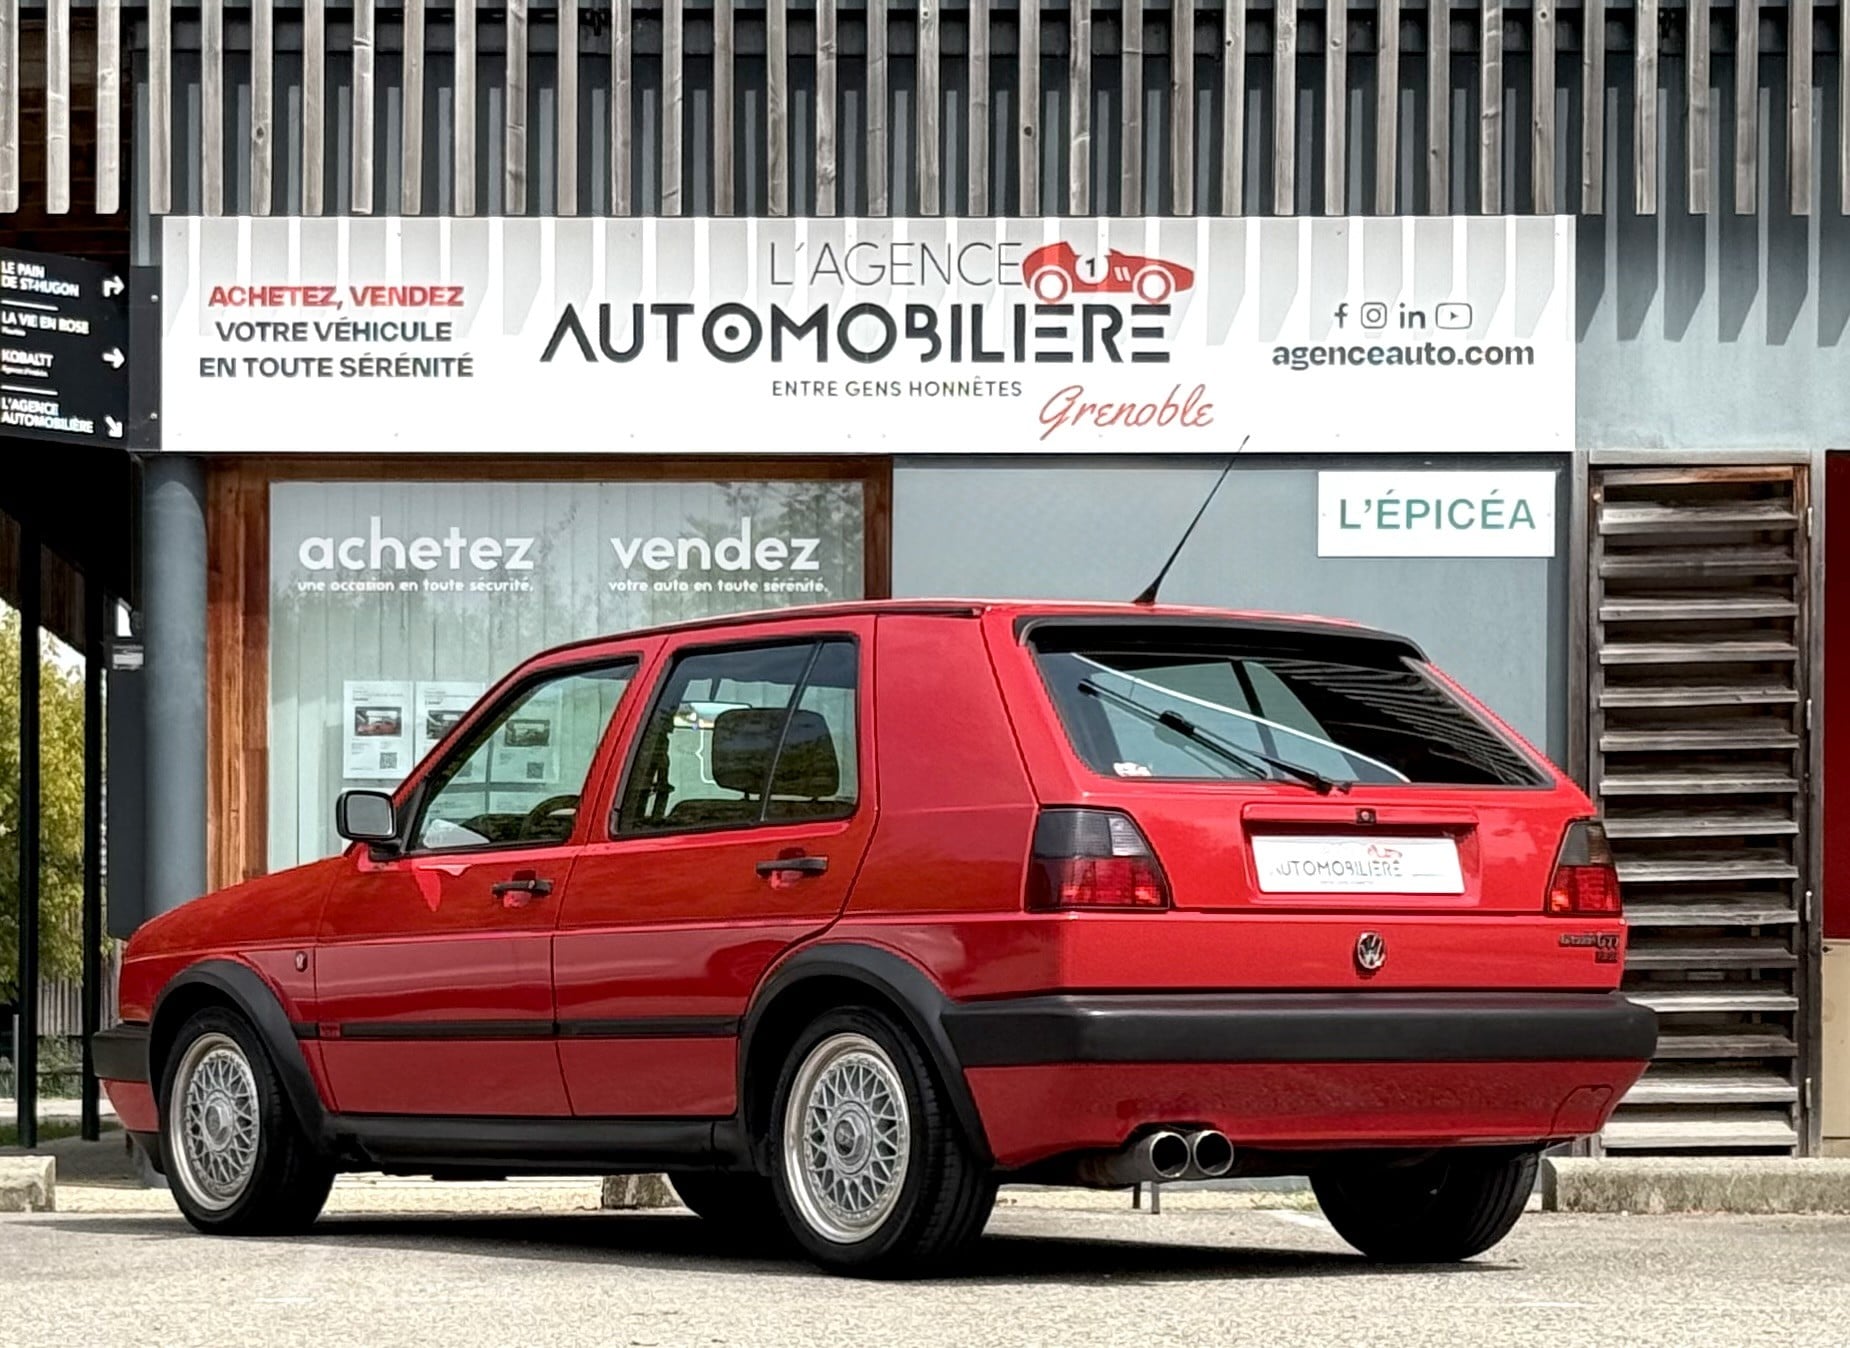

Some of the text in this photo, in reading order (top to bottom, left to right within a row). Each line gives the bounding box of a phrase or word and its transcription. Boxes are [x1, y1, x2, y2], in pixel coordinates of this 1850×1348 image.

[1, 260, 45, 278] LE PAIN
[1, 275, 18, 289] DE
[208, 286, 464, 311] ACHETEZ, VENDEZ
[2, 311, 90, 334] LA VIE EN ROSE
[215, 316, 452, 342] VOTRE VÉHICULE
[199, 352, 473, 378] EN TOUTE SÉRÉNITÉ
[1272, 342, 1535, 371] agenceauto.com
[772, 375, 1022, 397] ENTRE GENS HONNÊTES
[1, 396, 60, 417] L'AGENCE
[1039, 384, 1214, 441] Grenoble
[1339, 489, 1536, 530] L'ÉPICÉA
[298, 515, 535, 570] achetez
[610, 516, 821, 571] vendez
[297, 576, 534, 592] une occasion en toute sécurité.
[608, 579, 649, 592] votre
[653, 579, 689, 592] auto
[693, 580, 713, 592] en
[717, 579, 759, 592] toute
